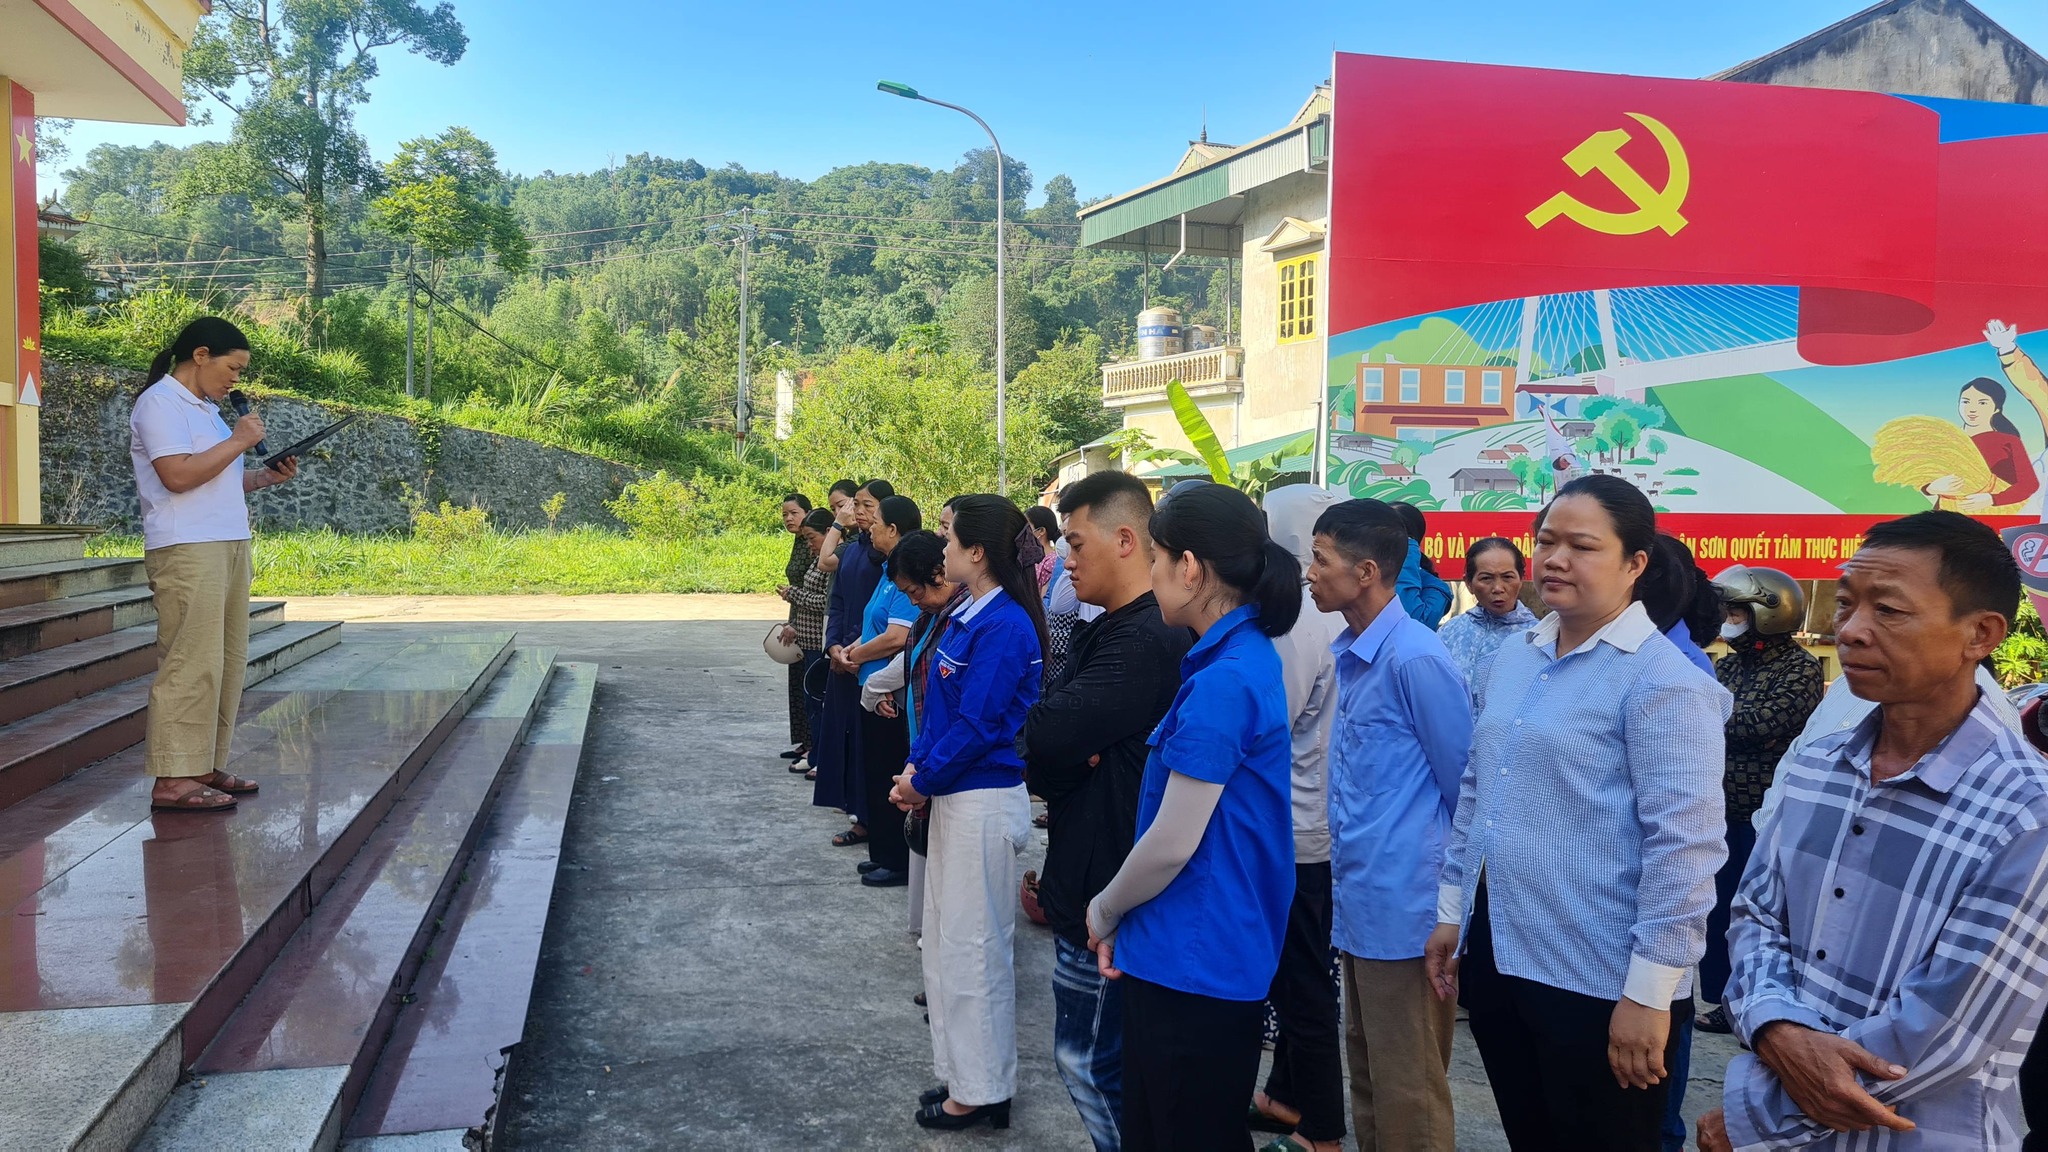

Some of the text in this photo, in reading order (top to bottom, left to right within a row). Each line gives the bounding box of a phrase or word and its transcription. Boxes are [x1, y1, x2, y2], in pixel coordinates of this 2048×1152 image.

[1424, 531, 1443, 564] BỘ
[1447, 531, 1466, 559] VÀ
[1699, 535, 1727, 559] SƠN
[1730, 530, 1771, 562] QUYẾT
[1773, 533, 1802, 559] TÂM
[1804, 535, 1838, 564] THỰC
